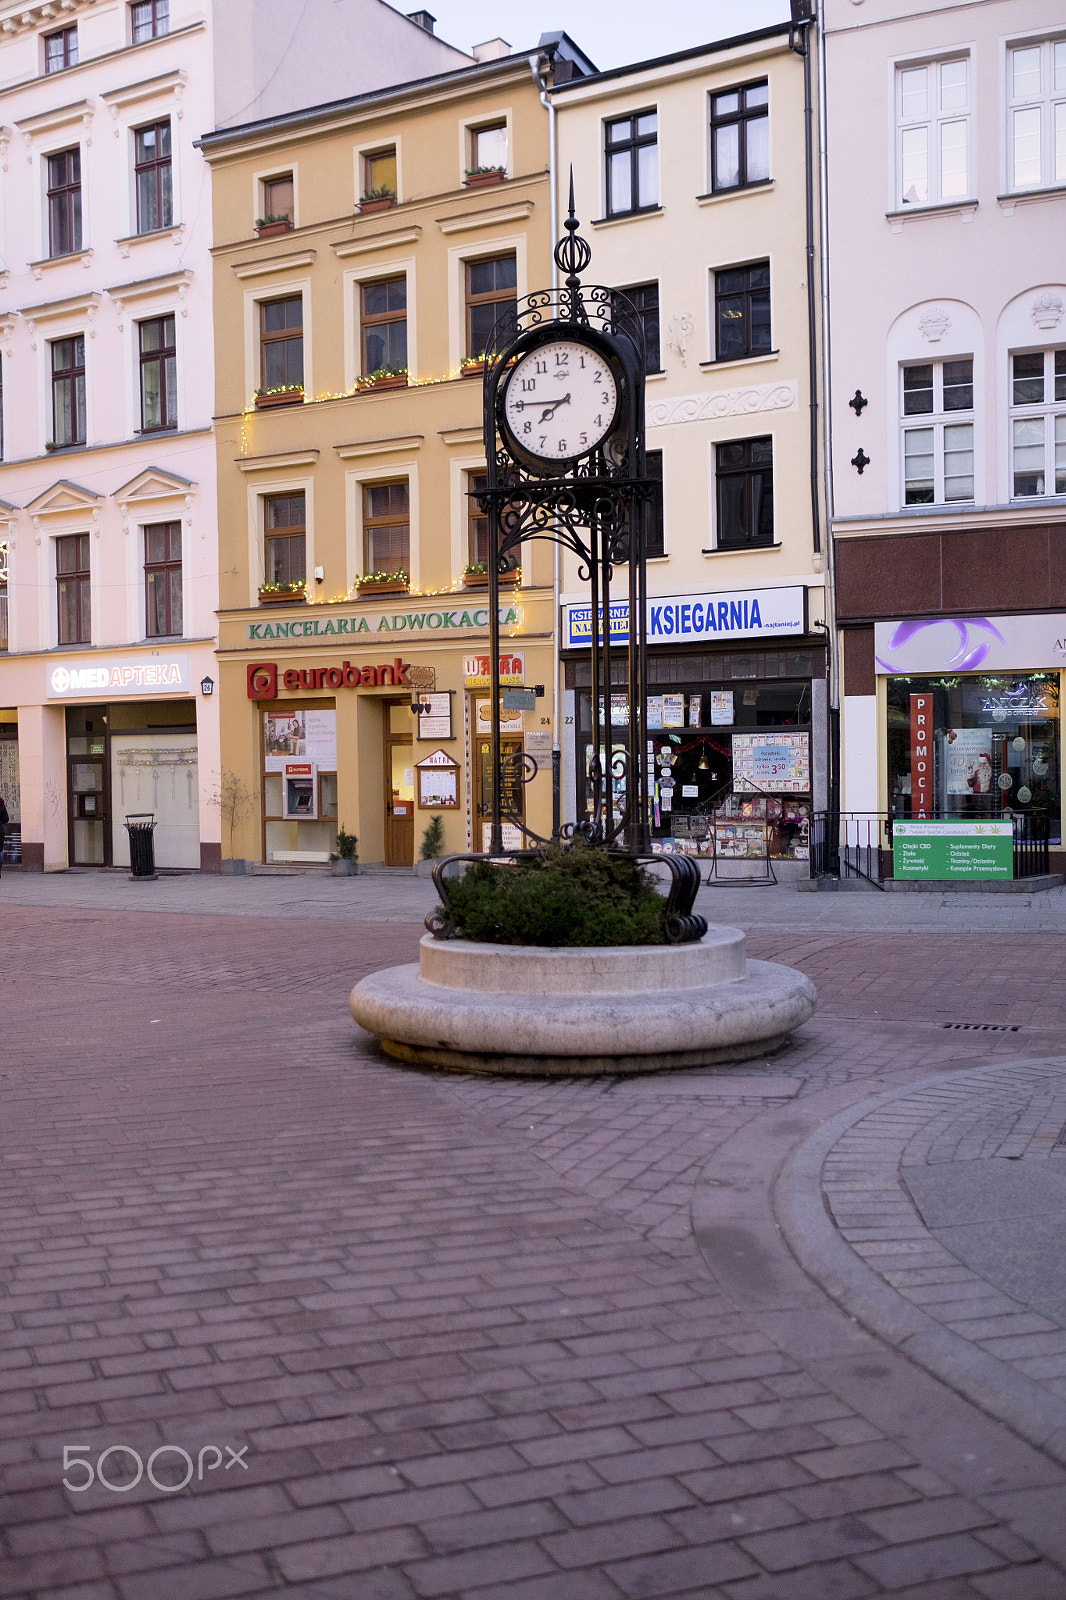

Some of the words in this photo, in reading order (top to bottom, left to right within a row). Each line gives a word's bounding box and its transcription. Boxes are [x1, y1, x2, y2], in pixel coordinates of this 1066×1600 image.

[554, 352, 569, 366] 12
[579, 356, 587, 369] 1
[535, 360, 548, 375] 11
[593, 371, 602, 384] 2
[521, 378, 536, 392] 10
[601, 391, 609, 405] 3
[516, 400, 525, 413] 9
[593, 414, 602, 427] 4
[523, 421, 532, 434] 8
[539, 434, 548, 449] 7
[558, 438, 567, 452] 6
[579, 432, 588, 445] 5
[249, 616, 371, 640] KANCELARIA
[575, 620, 629, 633] NAJIEJ
[283, 658, 411, 690] eurobank
[541, 716, 551, 725] 24
[565, 716, 574, 724] 22
[916, 698, 928, 818] PROMOCJA
[771, 764, 778, 775] 3
